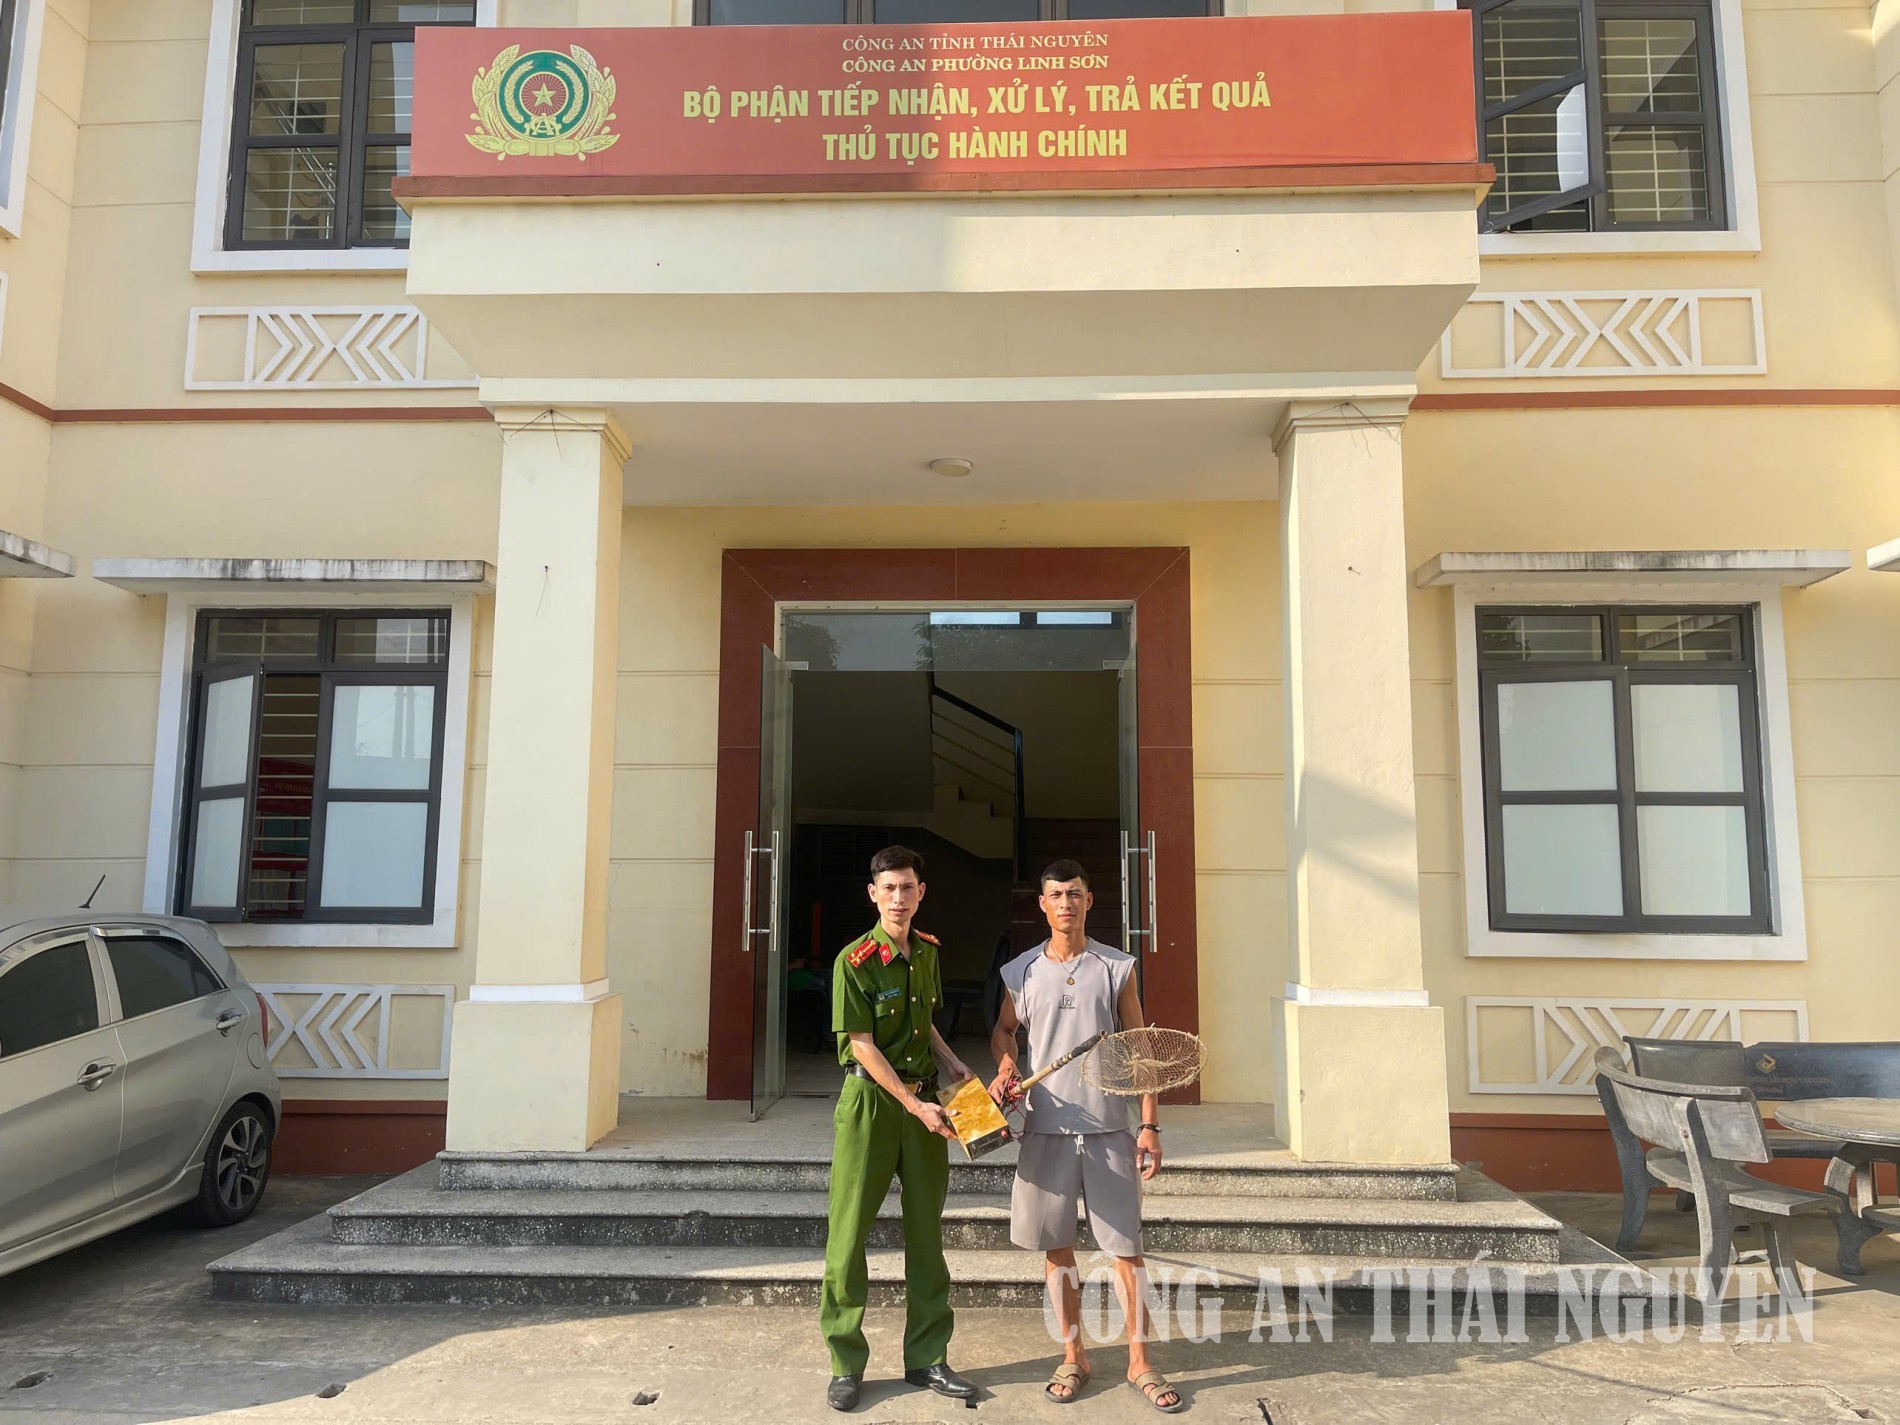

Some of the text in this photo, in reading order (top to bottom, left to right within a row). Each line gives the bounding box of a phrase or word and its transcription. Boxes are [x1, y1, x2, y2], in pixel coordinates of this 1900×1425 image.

[842, 31, 1108, 51] CÔNG AN TỈNH THÁI NGUYÊN
[841, 54, 1109, 73] CÔNG AN PHƯỜNG LINH SƠN
[683, 71, 1272, 124] BỘ PHẬN TIẾP NHẬN, XỬ LÝ, TRẢ KẾT QUẢ
[822, 124, 1127, 166] THỦ TỤC HÀNH CHÍNH
